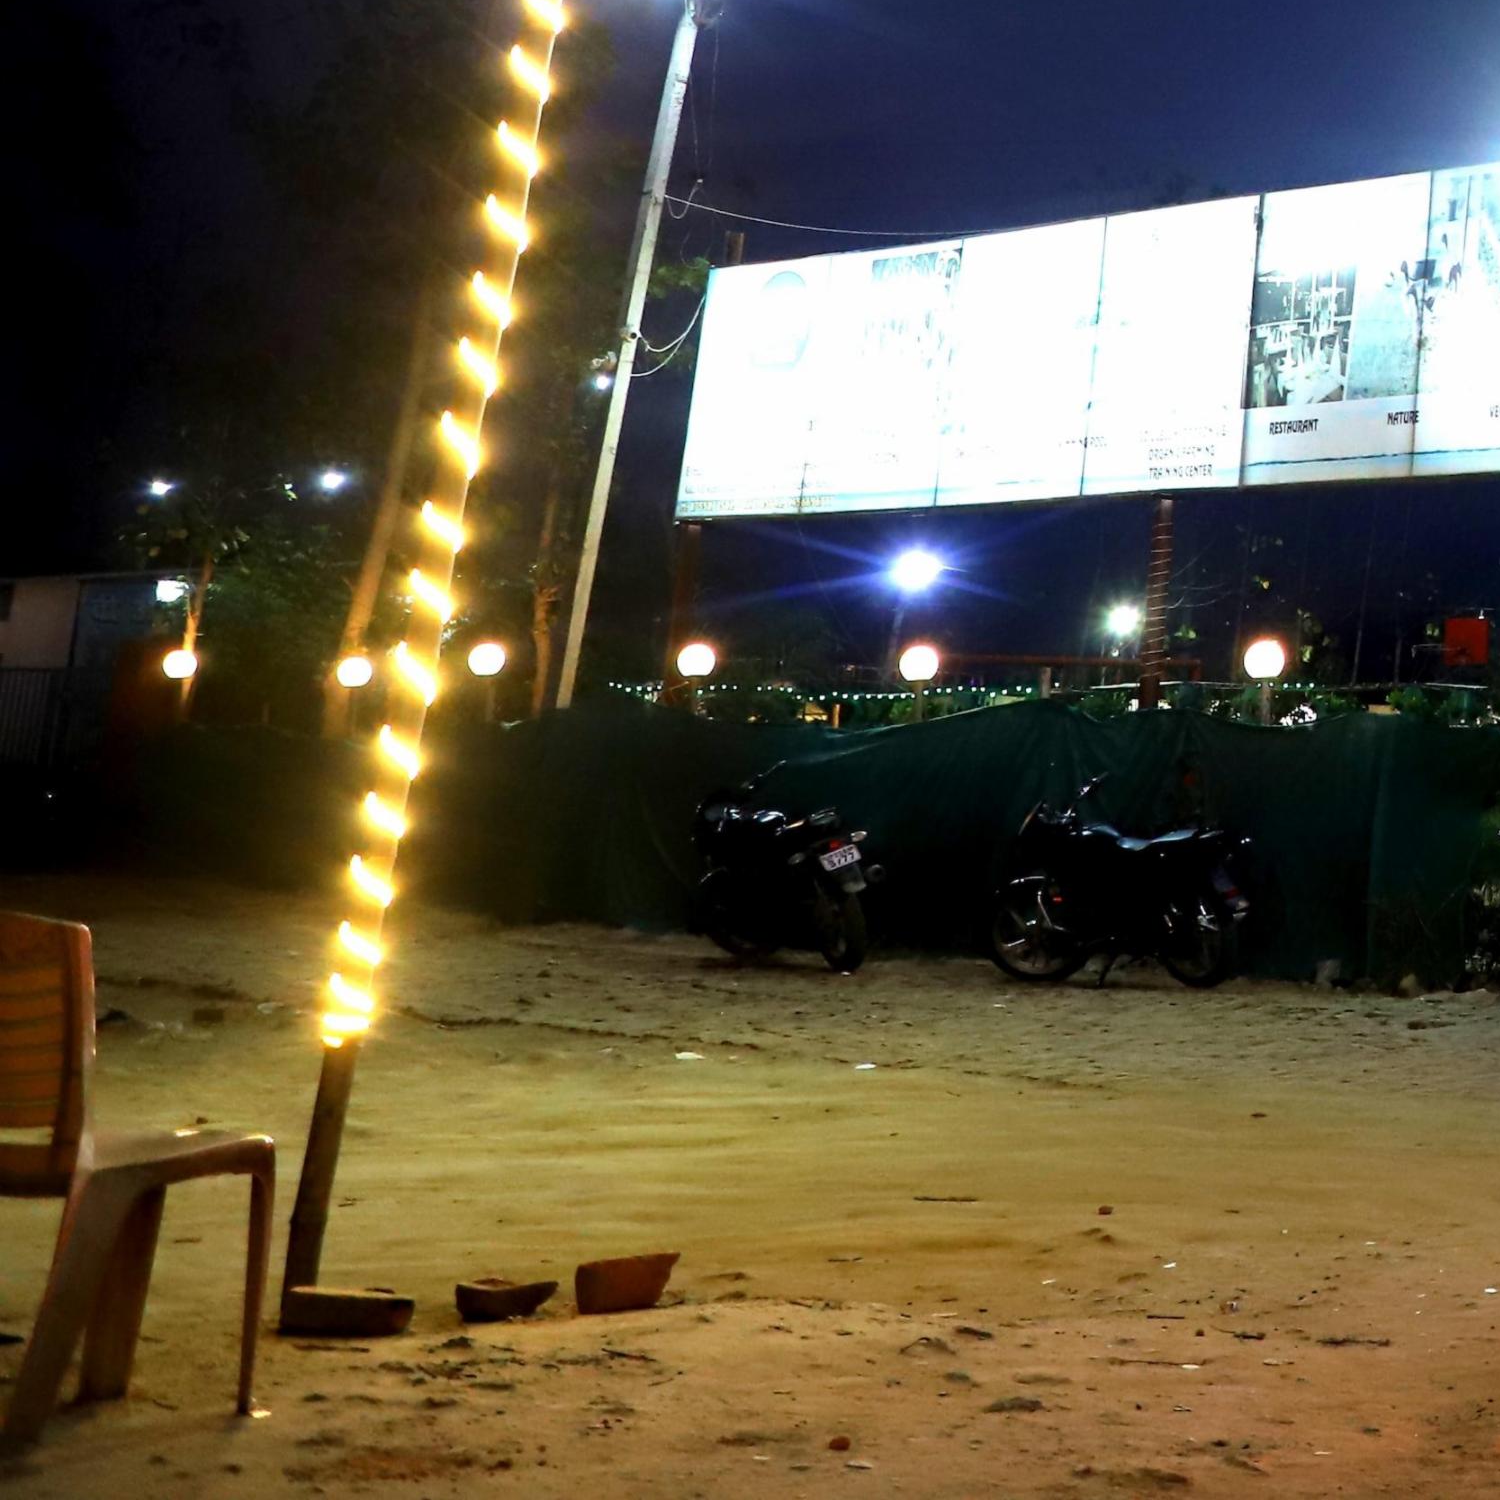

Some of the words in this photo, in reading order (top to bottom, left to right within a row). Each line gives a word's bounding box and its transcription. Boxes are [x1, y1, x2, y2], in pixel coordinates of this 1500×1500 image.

[1387, 410, 1420, 426] NATURE
[1269, 418, 1319, 436] RESTAURANT
[1149, 466, 1184, 480] TRANNG
[1185, 463, 1213, 477] CENTER
